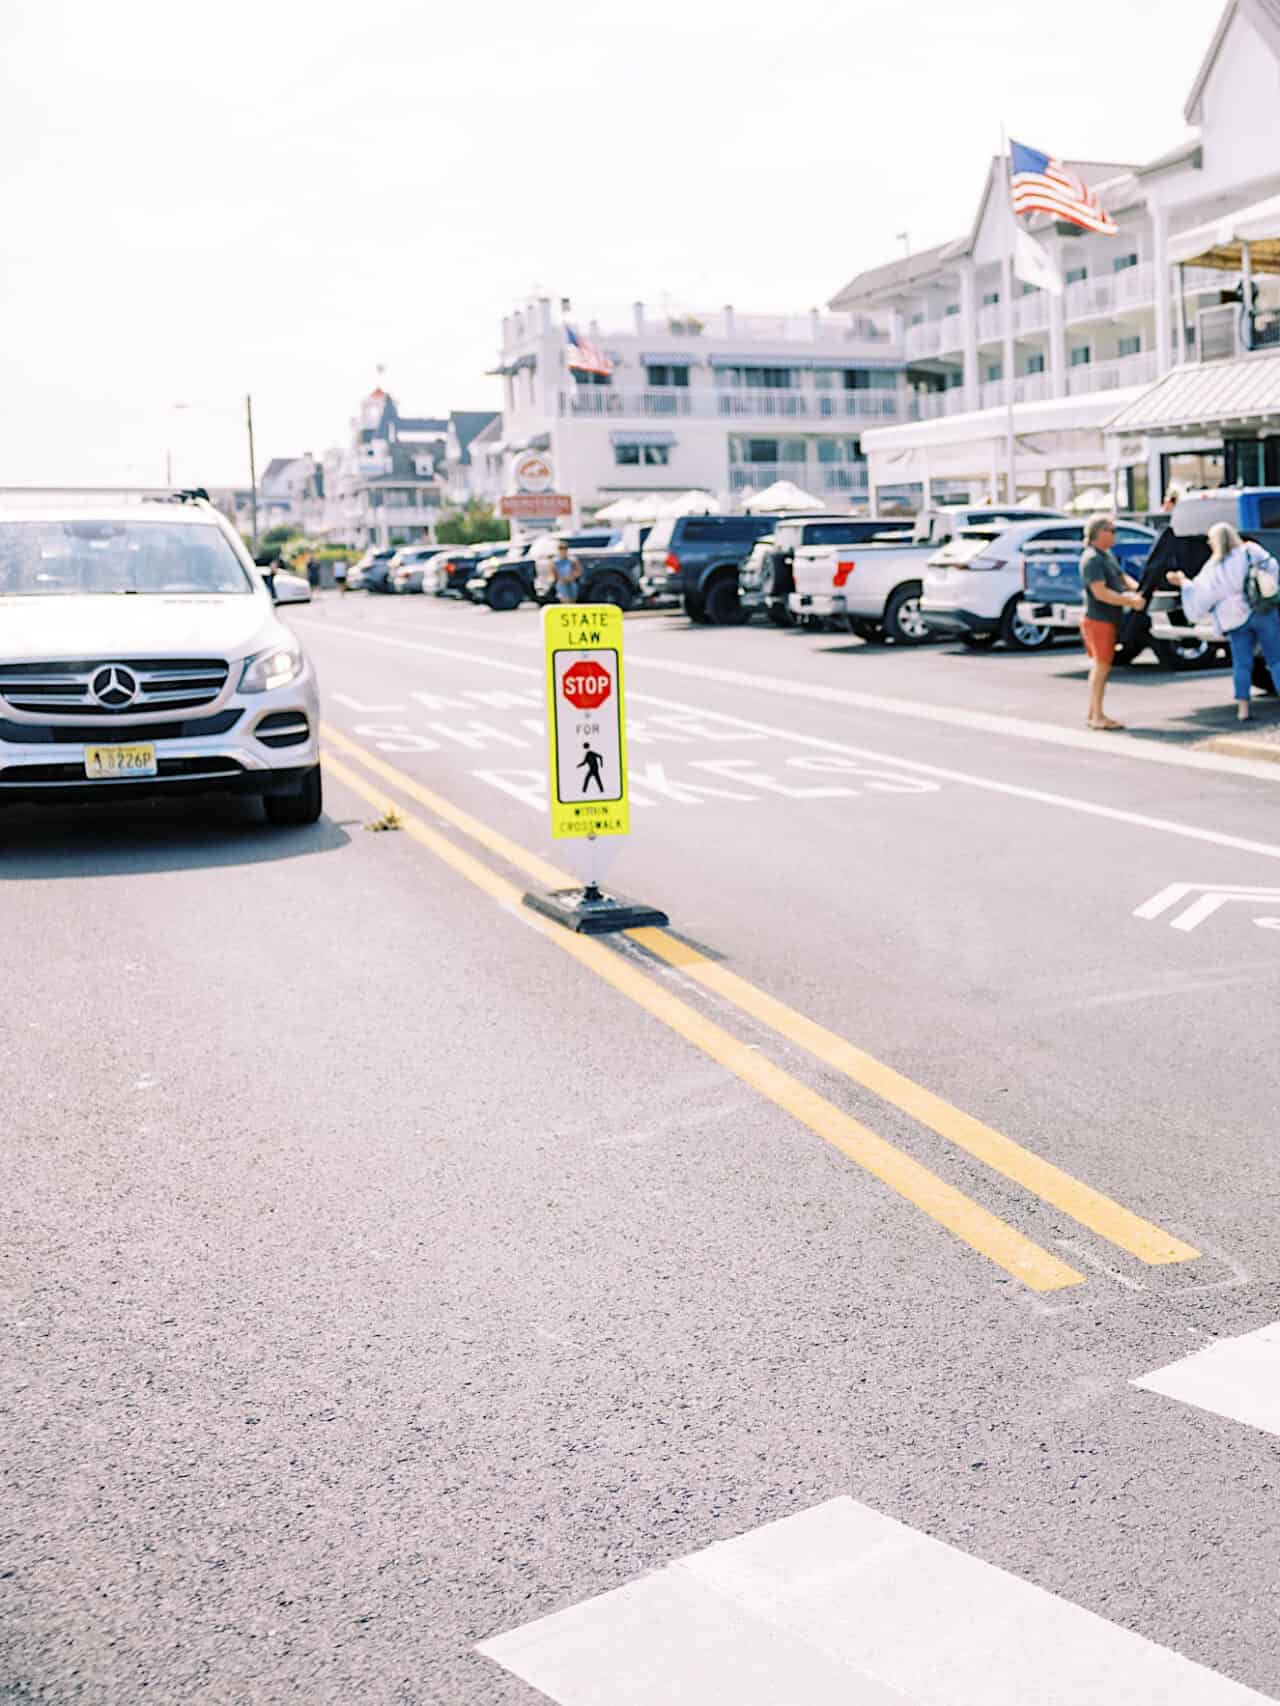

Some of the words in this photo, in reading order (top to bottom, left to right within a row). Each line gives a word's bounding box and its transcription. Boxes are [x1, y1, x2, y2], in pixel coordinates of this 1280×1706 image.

[561, 613, 609, 627] STATE
[569, 632, 601, 645] LAW
[565, 675, 609, 697] STOP
[353, 714, 770, 753] SHRE
[577, 724, 600, 735] FOR
[466, 756, 941, 809] BKES
[574, 807, 609, 817] WITHIN
[560, 820, 623, 832] CROSSWALK
